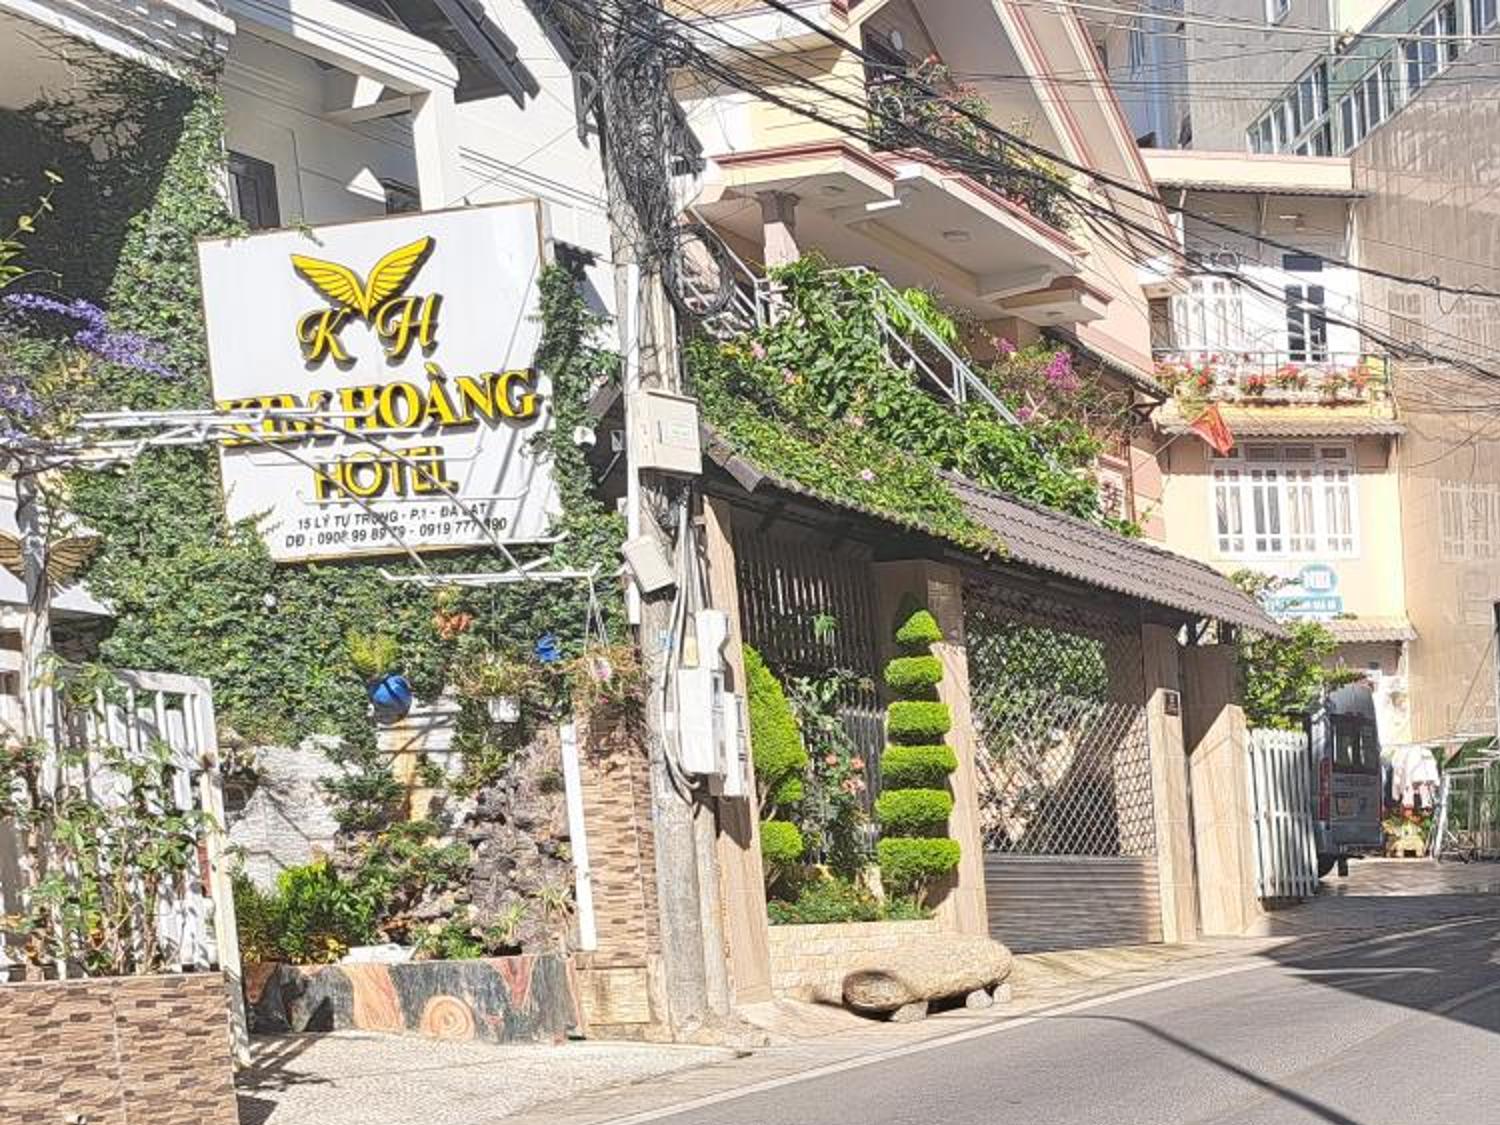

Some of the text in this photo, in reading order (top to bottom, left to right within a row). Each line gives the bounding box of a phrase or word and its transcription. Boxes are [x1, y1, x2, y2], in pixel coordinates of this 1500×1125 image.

[338, 361, 545, 430] HOÀNG
[313, 447, 458, 505] HOTEL
[299, 517, 311, 530] 15
[314, 513, 330, 529] LÝ
[351, 529, 367, 542] 99
[420, 522, 451, 536] 0919
